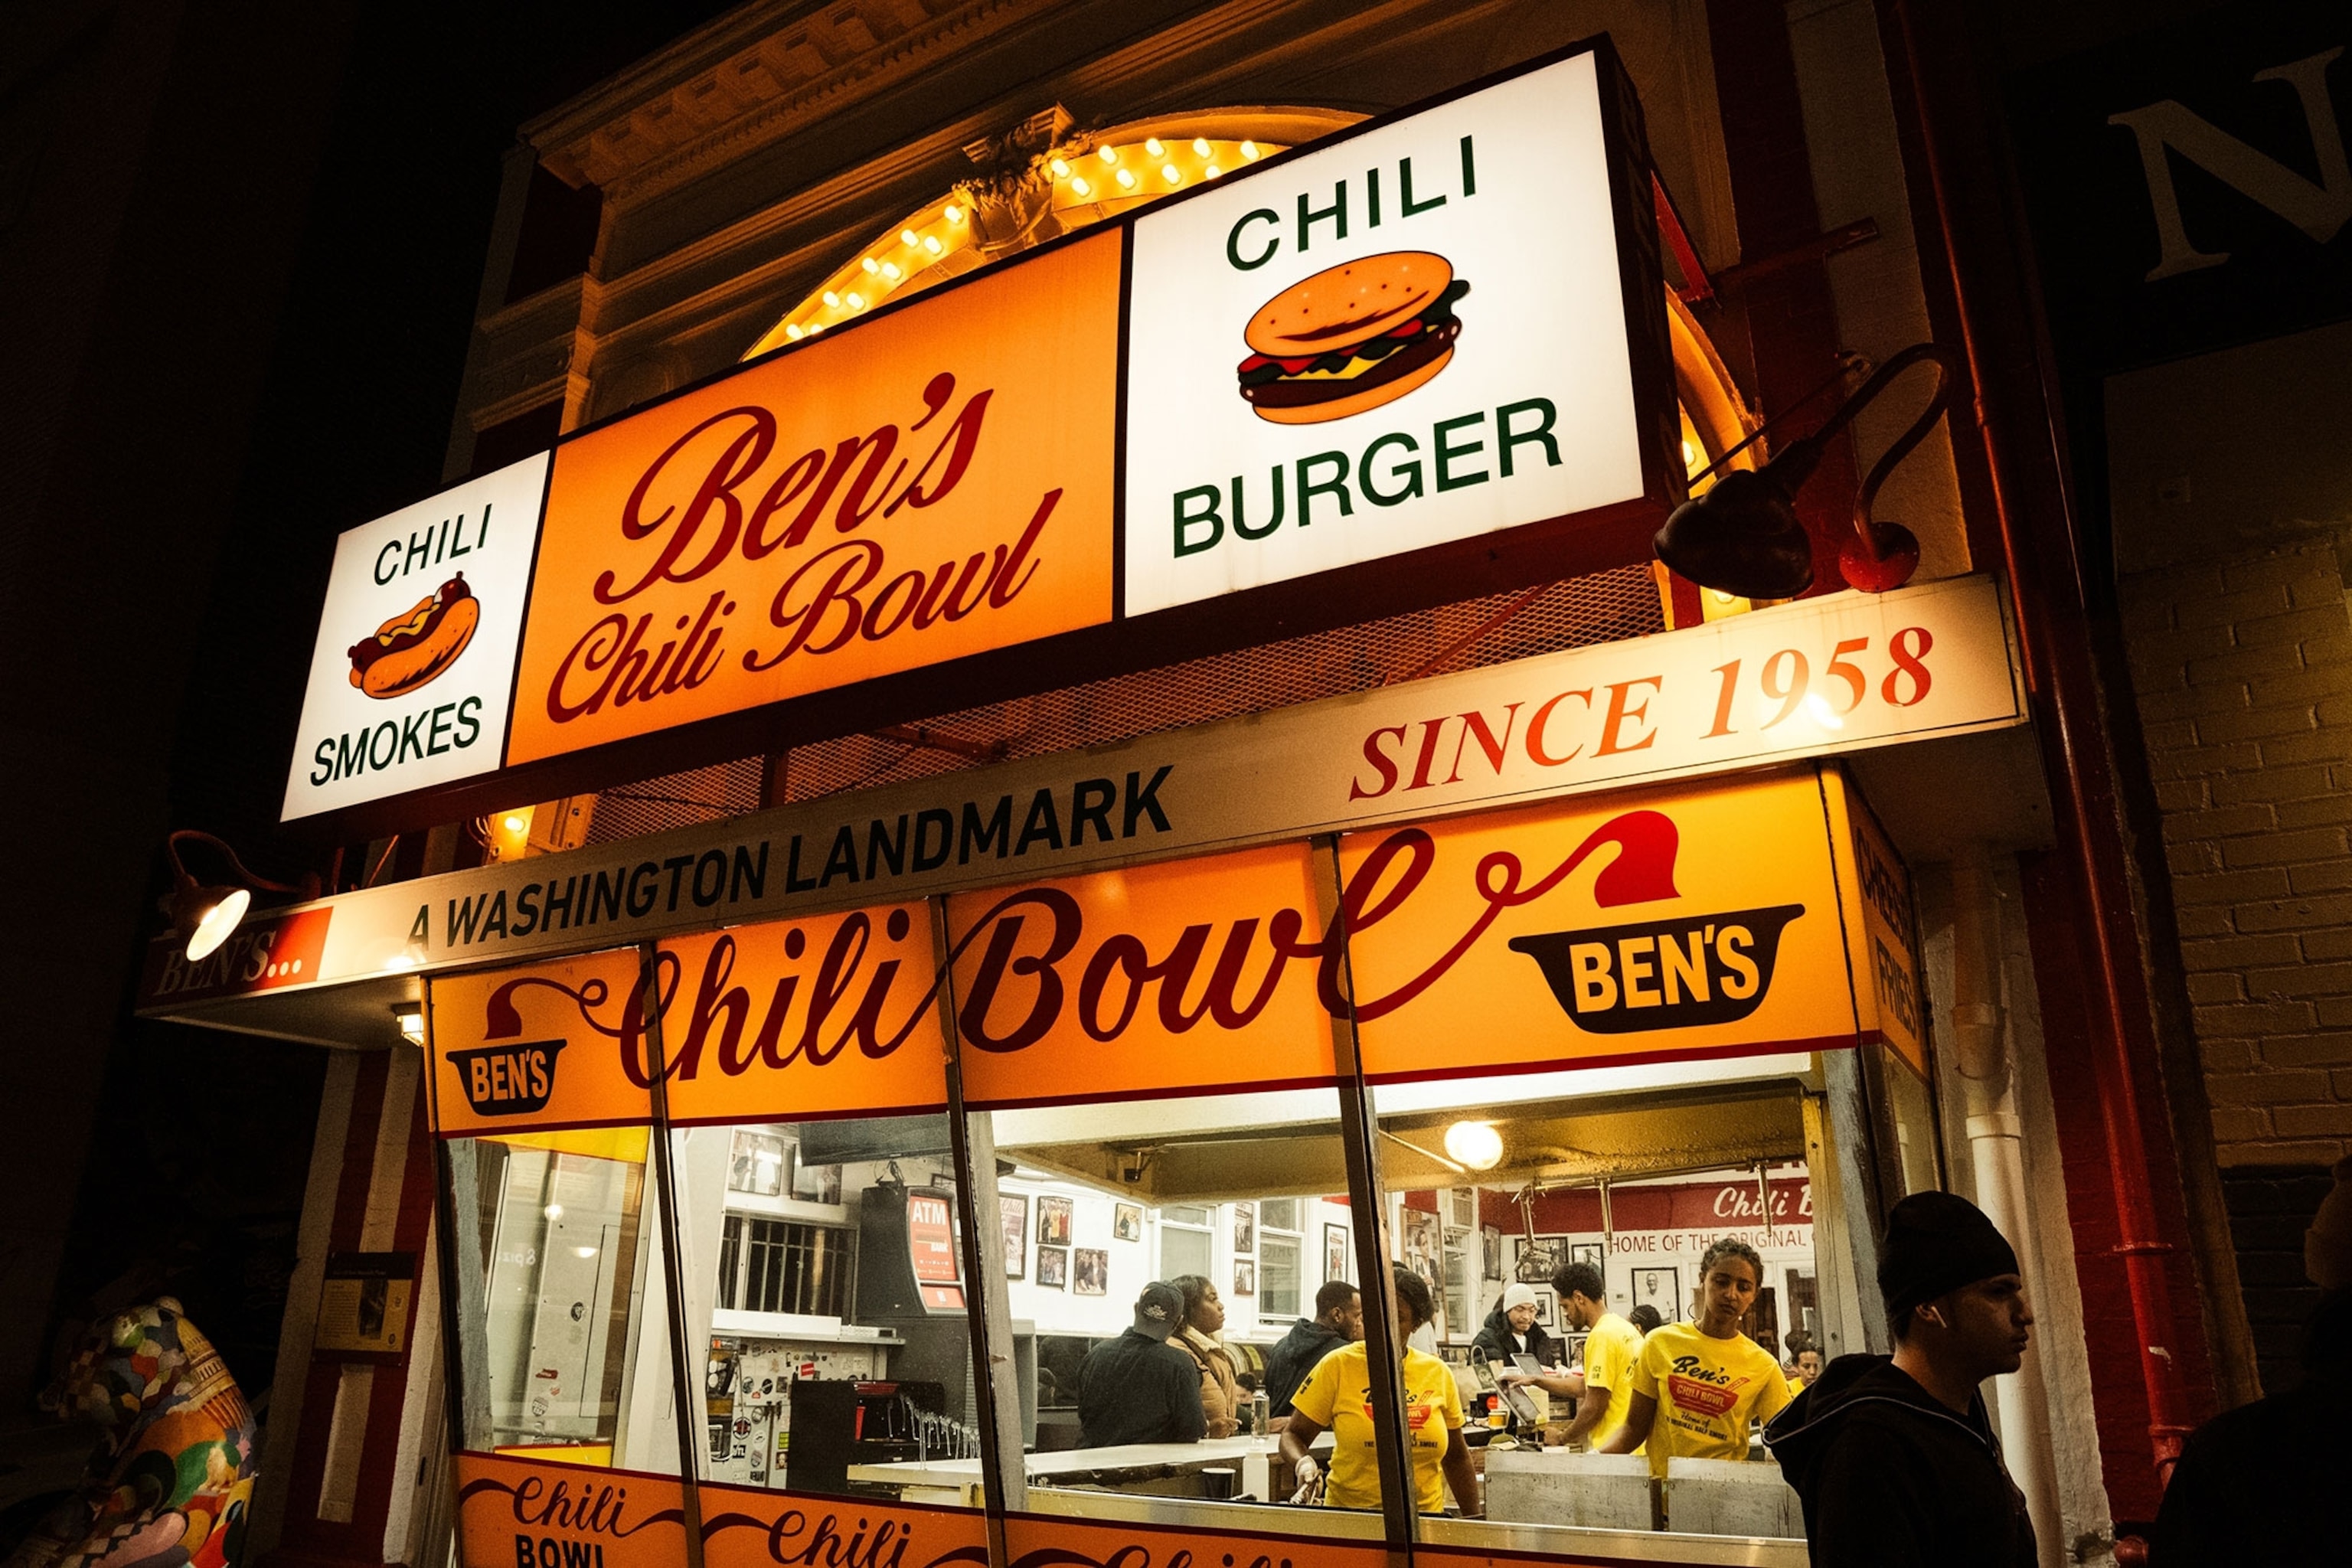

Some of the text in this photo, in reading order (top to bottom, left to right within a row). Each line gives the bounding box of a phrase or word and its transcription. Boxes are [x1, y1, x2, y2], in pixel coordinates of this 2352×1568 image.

[1225, 135, 1477, 271] CHILI
[593, 371, 995, 606] Ben's
[1172, 397, 1563, 559] BURGER
[373, 503, 493, 586] CHILI
[546, 487, 1064, 724] Chili Bowl
[309, 696, 483, 787] SMOKES
[1348, 626, 1934, 803] SINCE 1958
[406, 765, 1174, 952] A WASHINGTON LANDMARK
[619, 828, 1439, 1089] Chili Bowl
[1569, 923, 1761, 1014] BEN'S
[1876, 935, 1917, 1040] FRIES
[472, 1048, 549, 1103] BEN'S
[912, 1200, 947, 1226] ATM
[1612, 1235, 1656, 1253] HOME
[1662, 1234, 1683, 1251] OF
[1713, 1187, 1790, 1219] Chili
[1672, 1355, 1730, 1384] Ben's
[1676, 1383, 1726, 1407] CHILI BOWL
[513, 1475, 629, 1538] Chili
[768, 1510, 912, 1568] Chili
